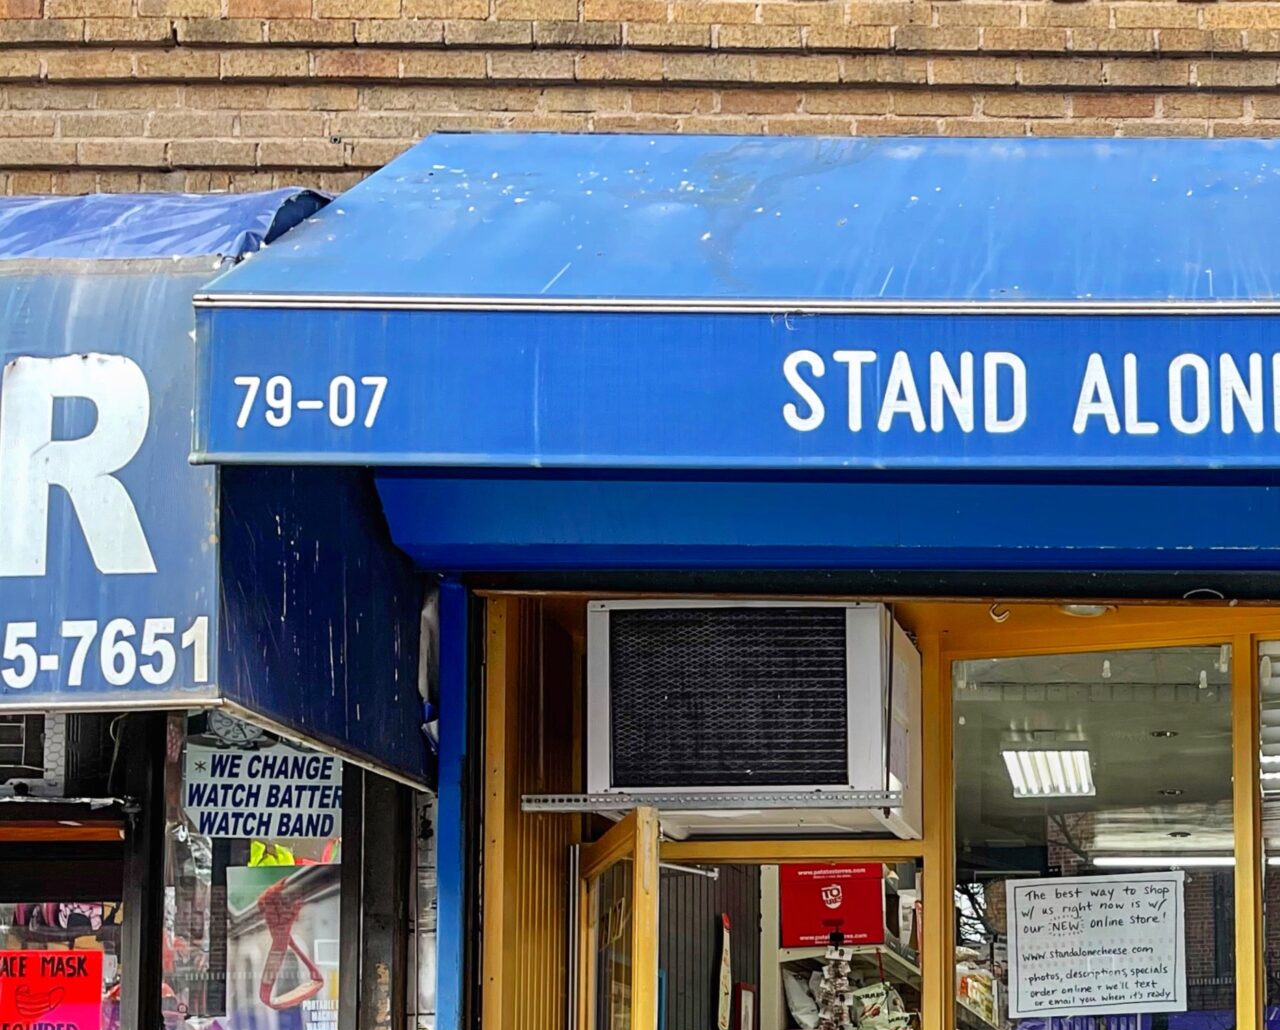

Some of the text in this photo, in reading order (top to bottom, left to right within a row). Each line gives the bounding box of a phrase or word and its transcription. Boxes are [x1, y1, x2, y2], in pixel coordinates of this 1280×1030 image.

[234, 375, 388, 429] 79-07
[782, 349, 1027, 433] STAND
[0, 352, 158, 576] R
[1, 616, 209, 690] 5-7651
[210, 754, 334, 780] WE CHANGE
[188, 783, 261, 808] WATCH
[199, 811, 334, 837] WATCH BAND
[1025, 884, 1170, 902] The best way to shop
[1042, 905, 1054, 915] us
[1062, 901, 1093, 919] right
[1099, 901, 1124, 910] now
[1131, 899, 1141, 910] is
[1023, 924, 1044, 935] our
[1052, 921, 1080, 932] NEW
[1090, 915, 1124, 929] online
[0, 955, 89, 978] ACE MASK
[1130, 963, 1169, 976] specials
[1030, 987, 1057, 998] order
[1062, 985, 1092, 996] online
[1134, 979, 1157, 989] text
[1078, 996, 1097, 1005] you
[1101, 992, 1125, 1001] when
